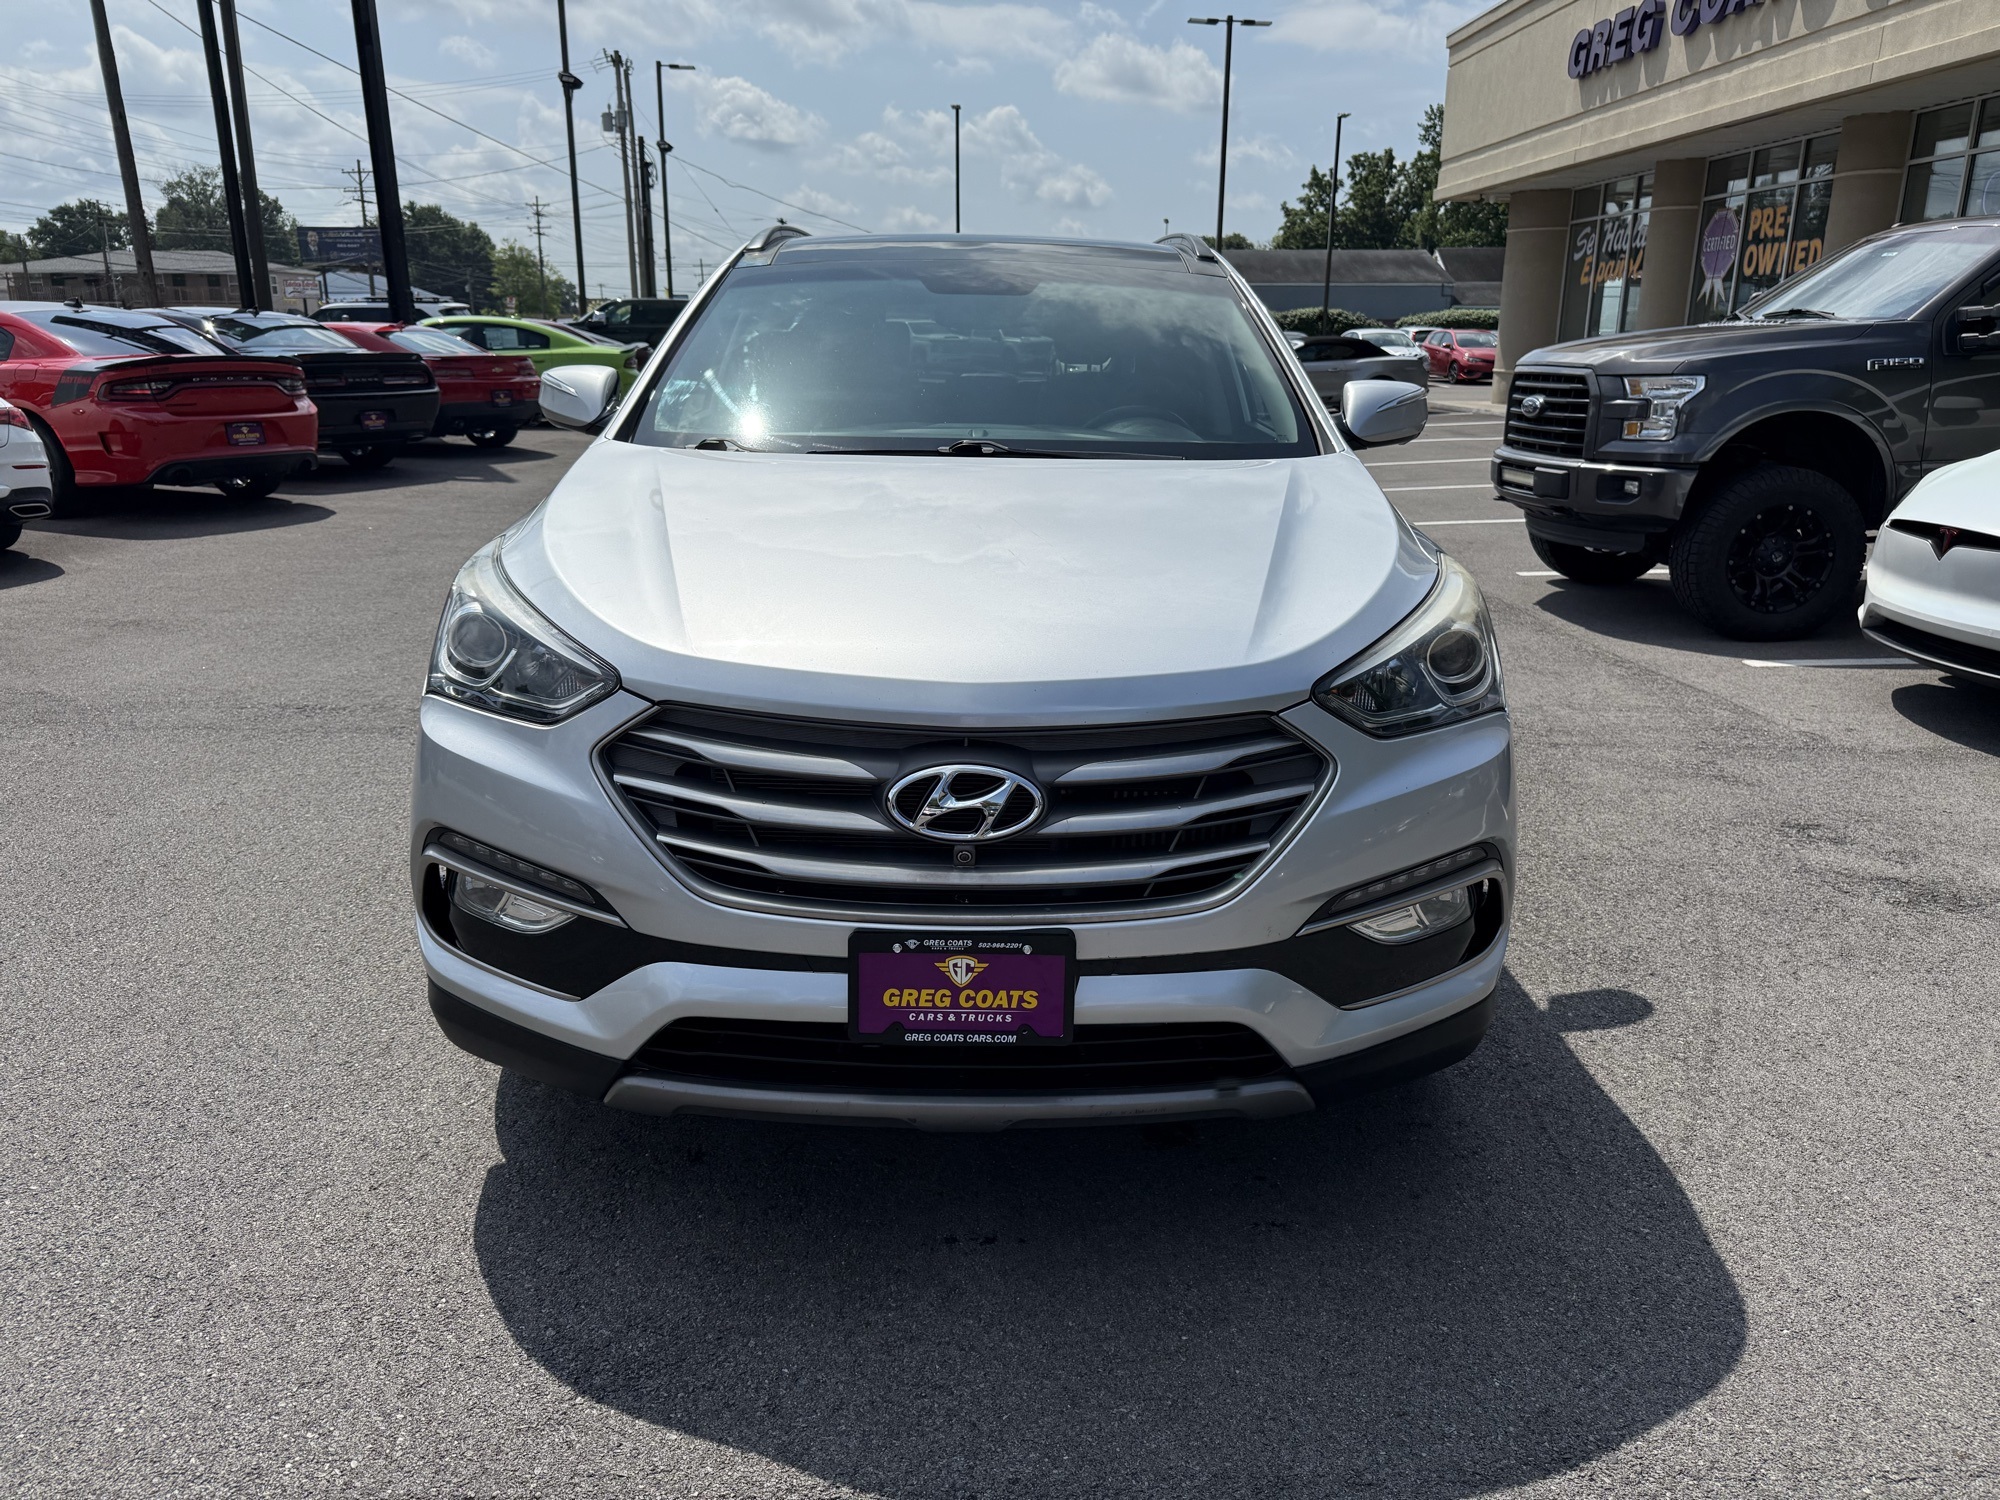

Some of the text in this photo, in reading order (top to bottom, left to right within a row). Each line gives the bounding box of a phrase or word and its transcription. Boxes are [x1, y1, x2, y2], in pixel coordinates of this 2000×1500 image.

[1568, 0, 1665, 79] GREG
[1574, 226, 1596, 261] Se
[1703, 235, 1737, 253] CERTIFIED
[1743, 238, 1823, 277] OWNED
[947, 939, 973, 947] COATS
[882, 988, 1039, 1009] GREG COATS
[908, 1012, 1013, 1023] CARS & TRUCKS
[904, 1033, 1017, 1043] GREG COATS CARS.COM
